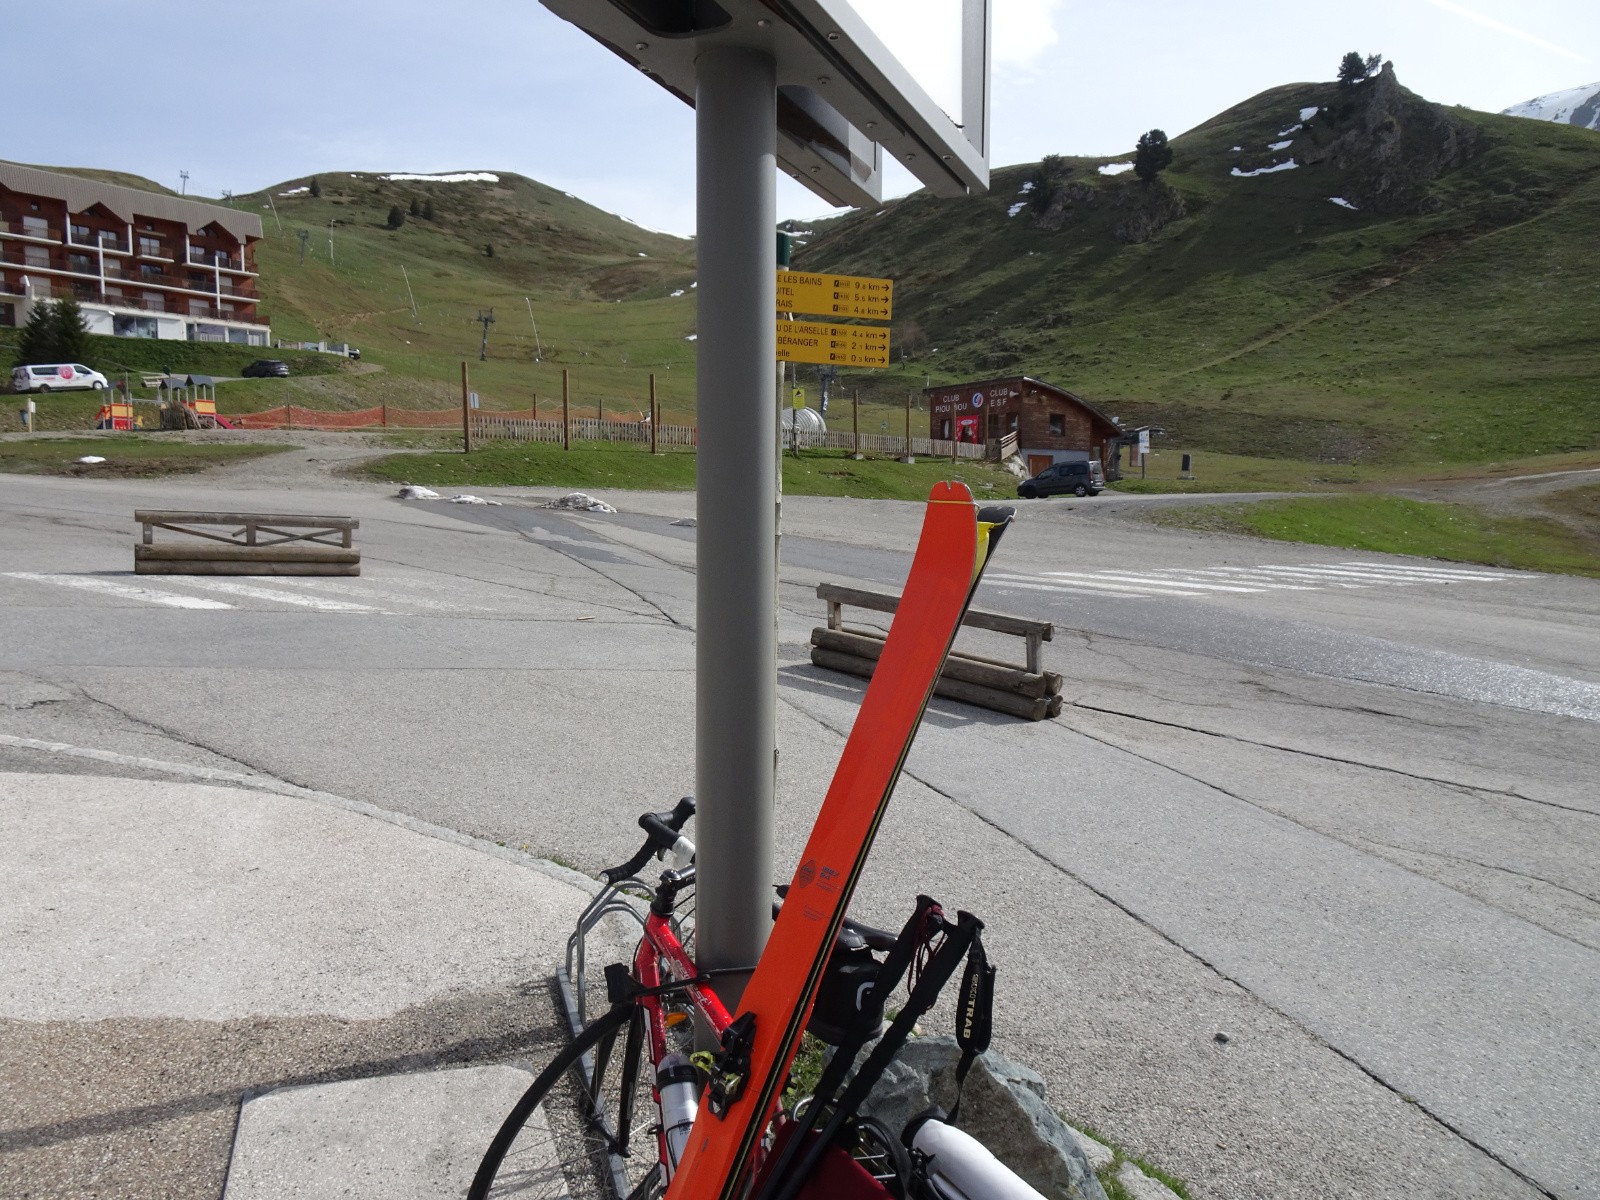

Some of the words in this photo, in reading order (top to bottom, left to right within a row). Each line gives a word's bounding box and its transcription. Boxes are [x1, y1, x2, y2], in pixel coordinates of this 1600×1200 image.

[783, 275, 798, 284] LES
[799, 276, 823, 286] BAINS
[868, 283, 880, 291] km
[854, 293, 866, 302] 5.6
[868, 295, 880, 303] km
[867, 307, 879, 316] km
[783, 324, 793, 333] DE
[794, 325, 829, 336] L'ARSELLE
[865, 331, 878, 339] km
[777, 335, 819, 347] BÉRANGER
[865, 343, 877, 351] km
[864, 354, 876, 363] km
[990, 388, 1008, 397] CLUB
[943, 395, 960, 403] CLUB
[935, 405, 951, 413] PIOU
